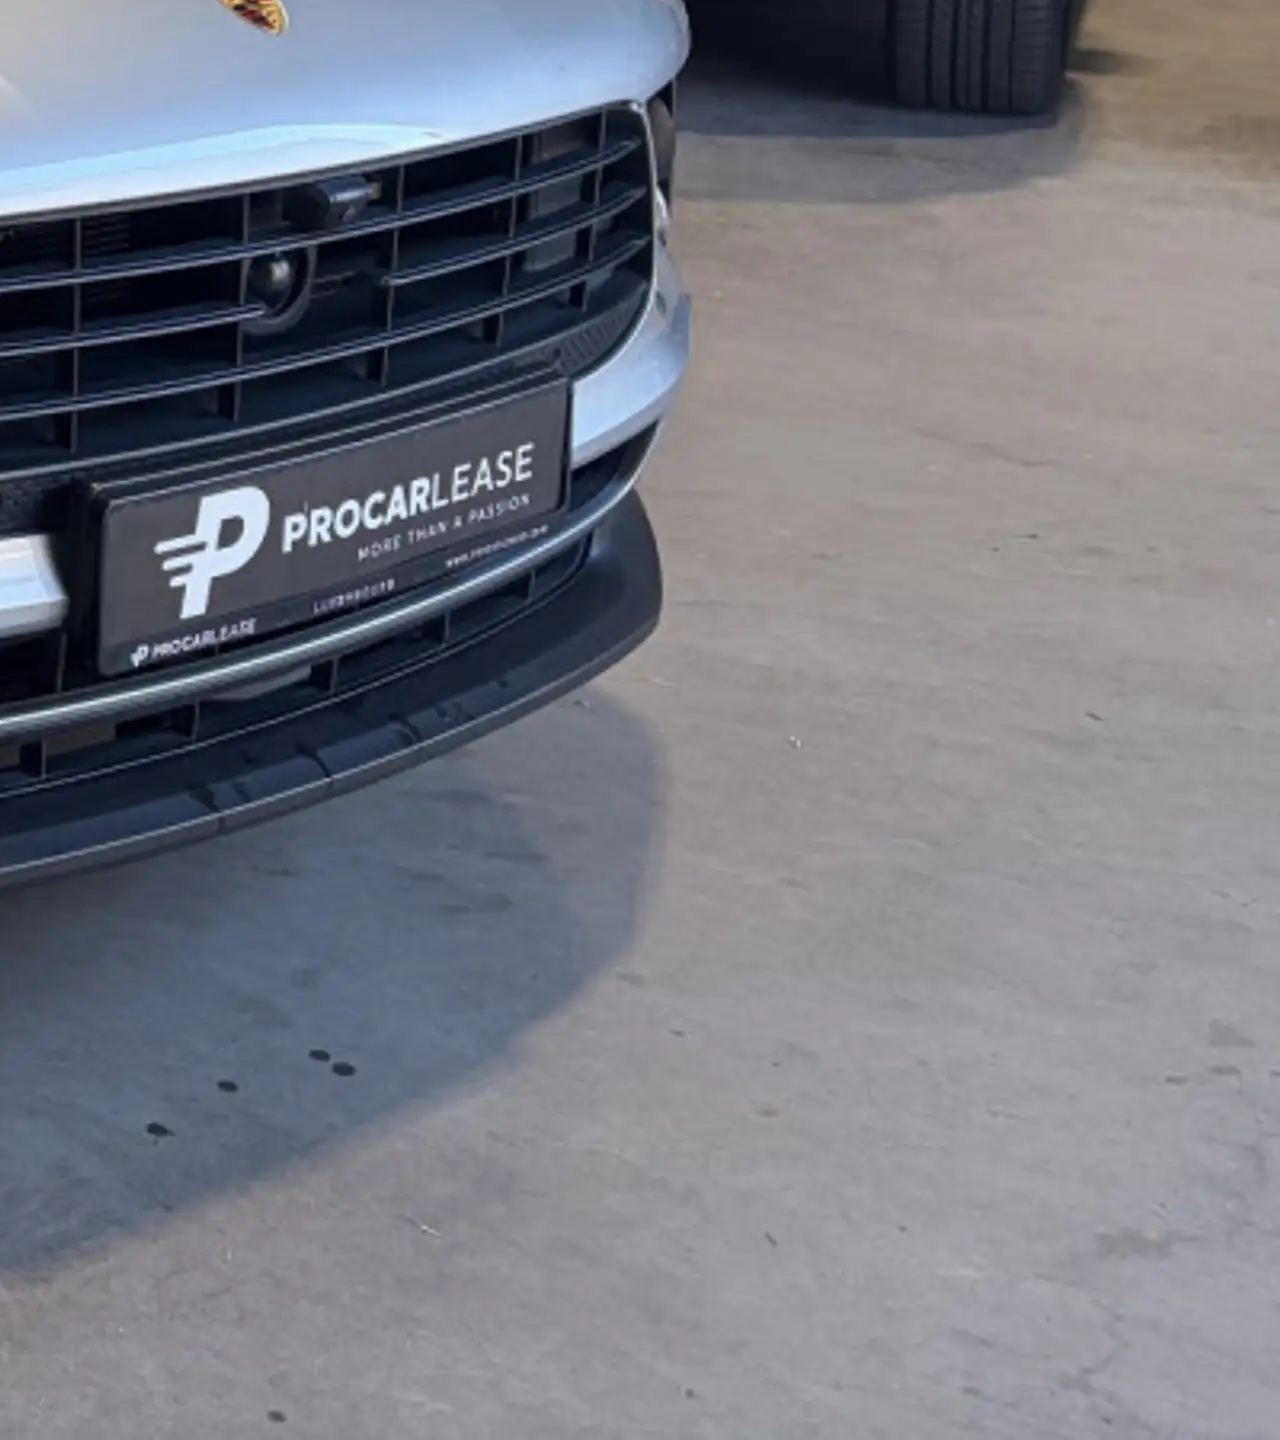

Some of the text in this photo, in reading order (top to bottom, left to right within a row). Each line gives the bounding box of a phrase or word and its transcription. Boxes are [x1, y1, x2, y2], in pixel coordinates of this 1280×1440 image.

[281, 442, 536, 554] PROCARLEASE
[357, 493, 531, 561] MORE THAN A PASSION
[151, 617, 258, 659] PROCARLEASE
